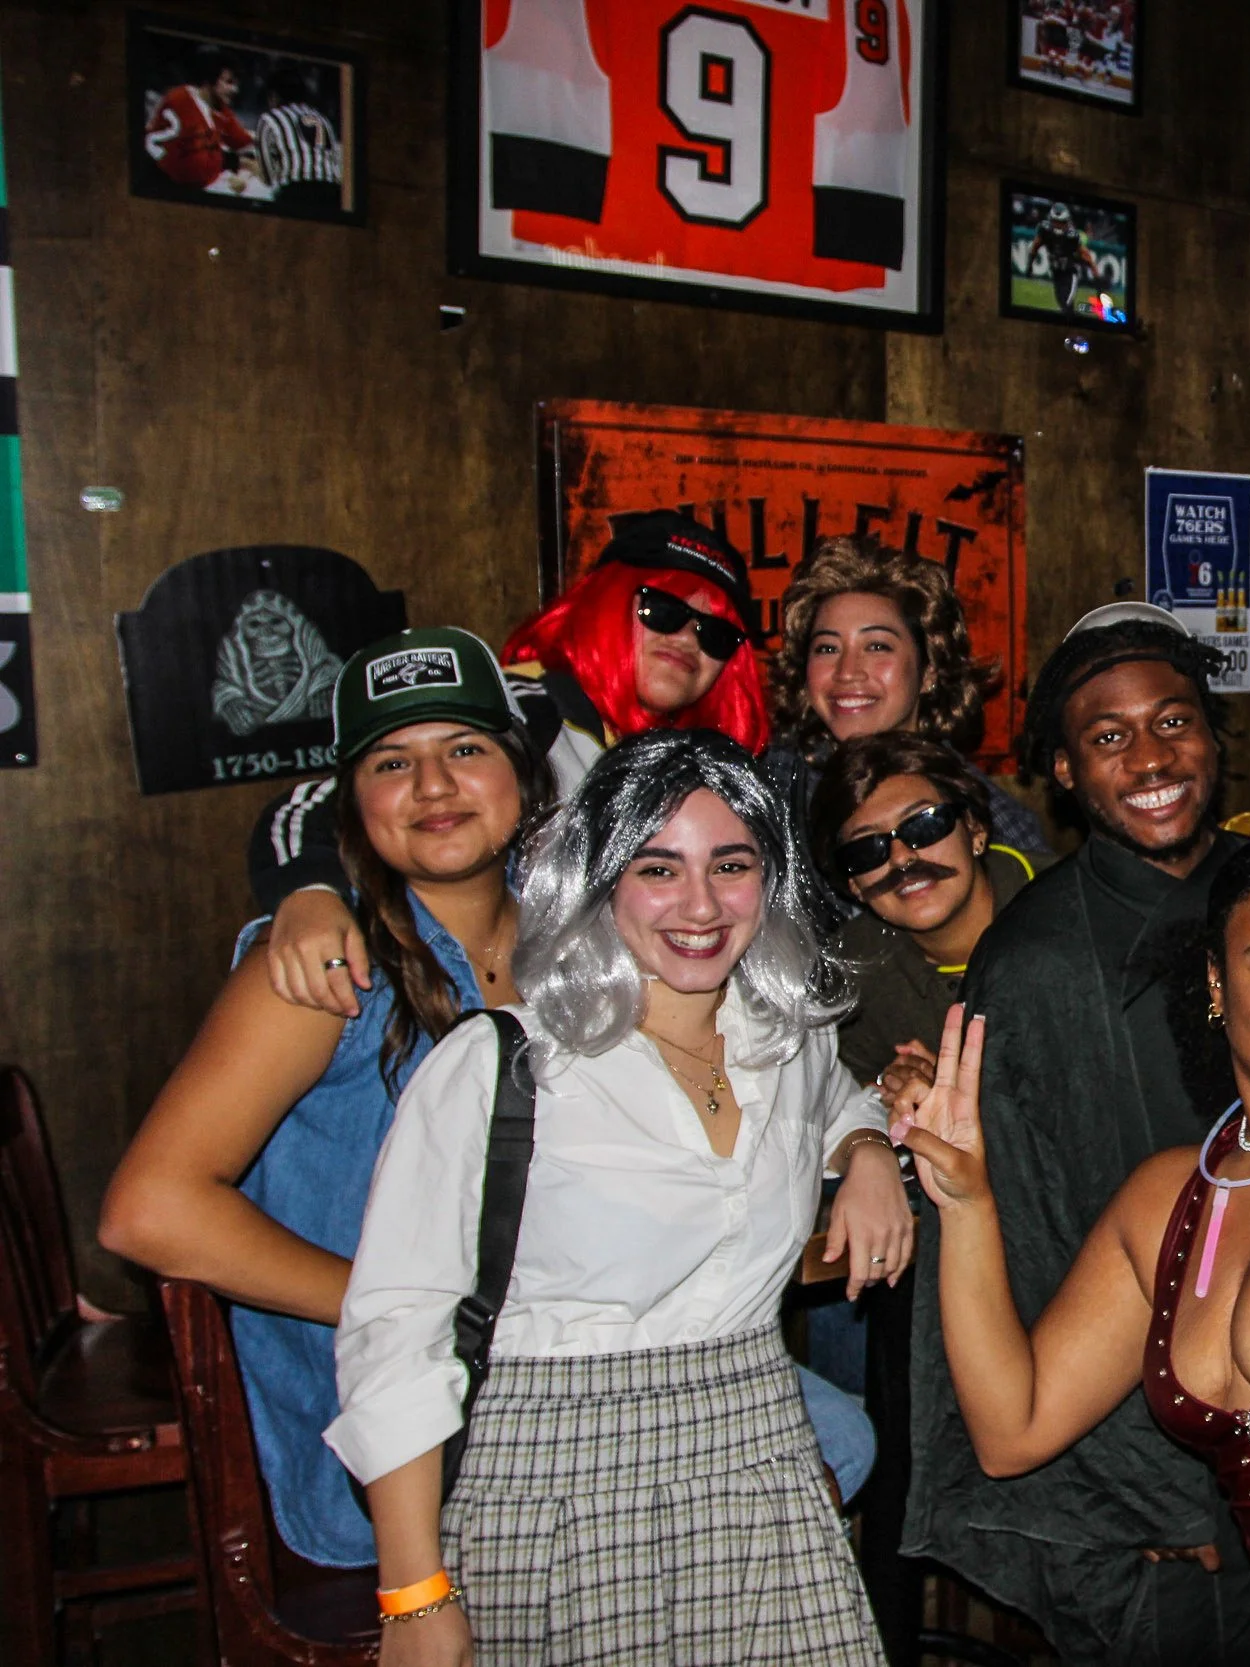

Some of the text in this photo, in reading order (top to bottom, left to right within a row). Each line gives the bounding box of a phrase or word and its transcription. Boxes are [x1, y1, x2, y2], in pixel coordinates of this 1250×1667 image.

[856, 0, 890, 66] 9
[657, 5, 772, 232] 9
[1175, 504, 1226, 519] WATCH
[1176, 519, 1225, 533] 76ERS
[1169, 534, 1230, 545] GAMES HERE
